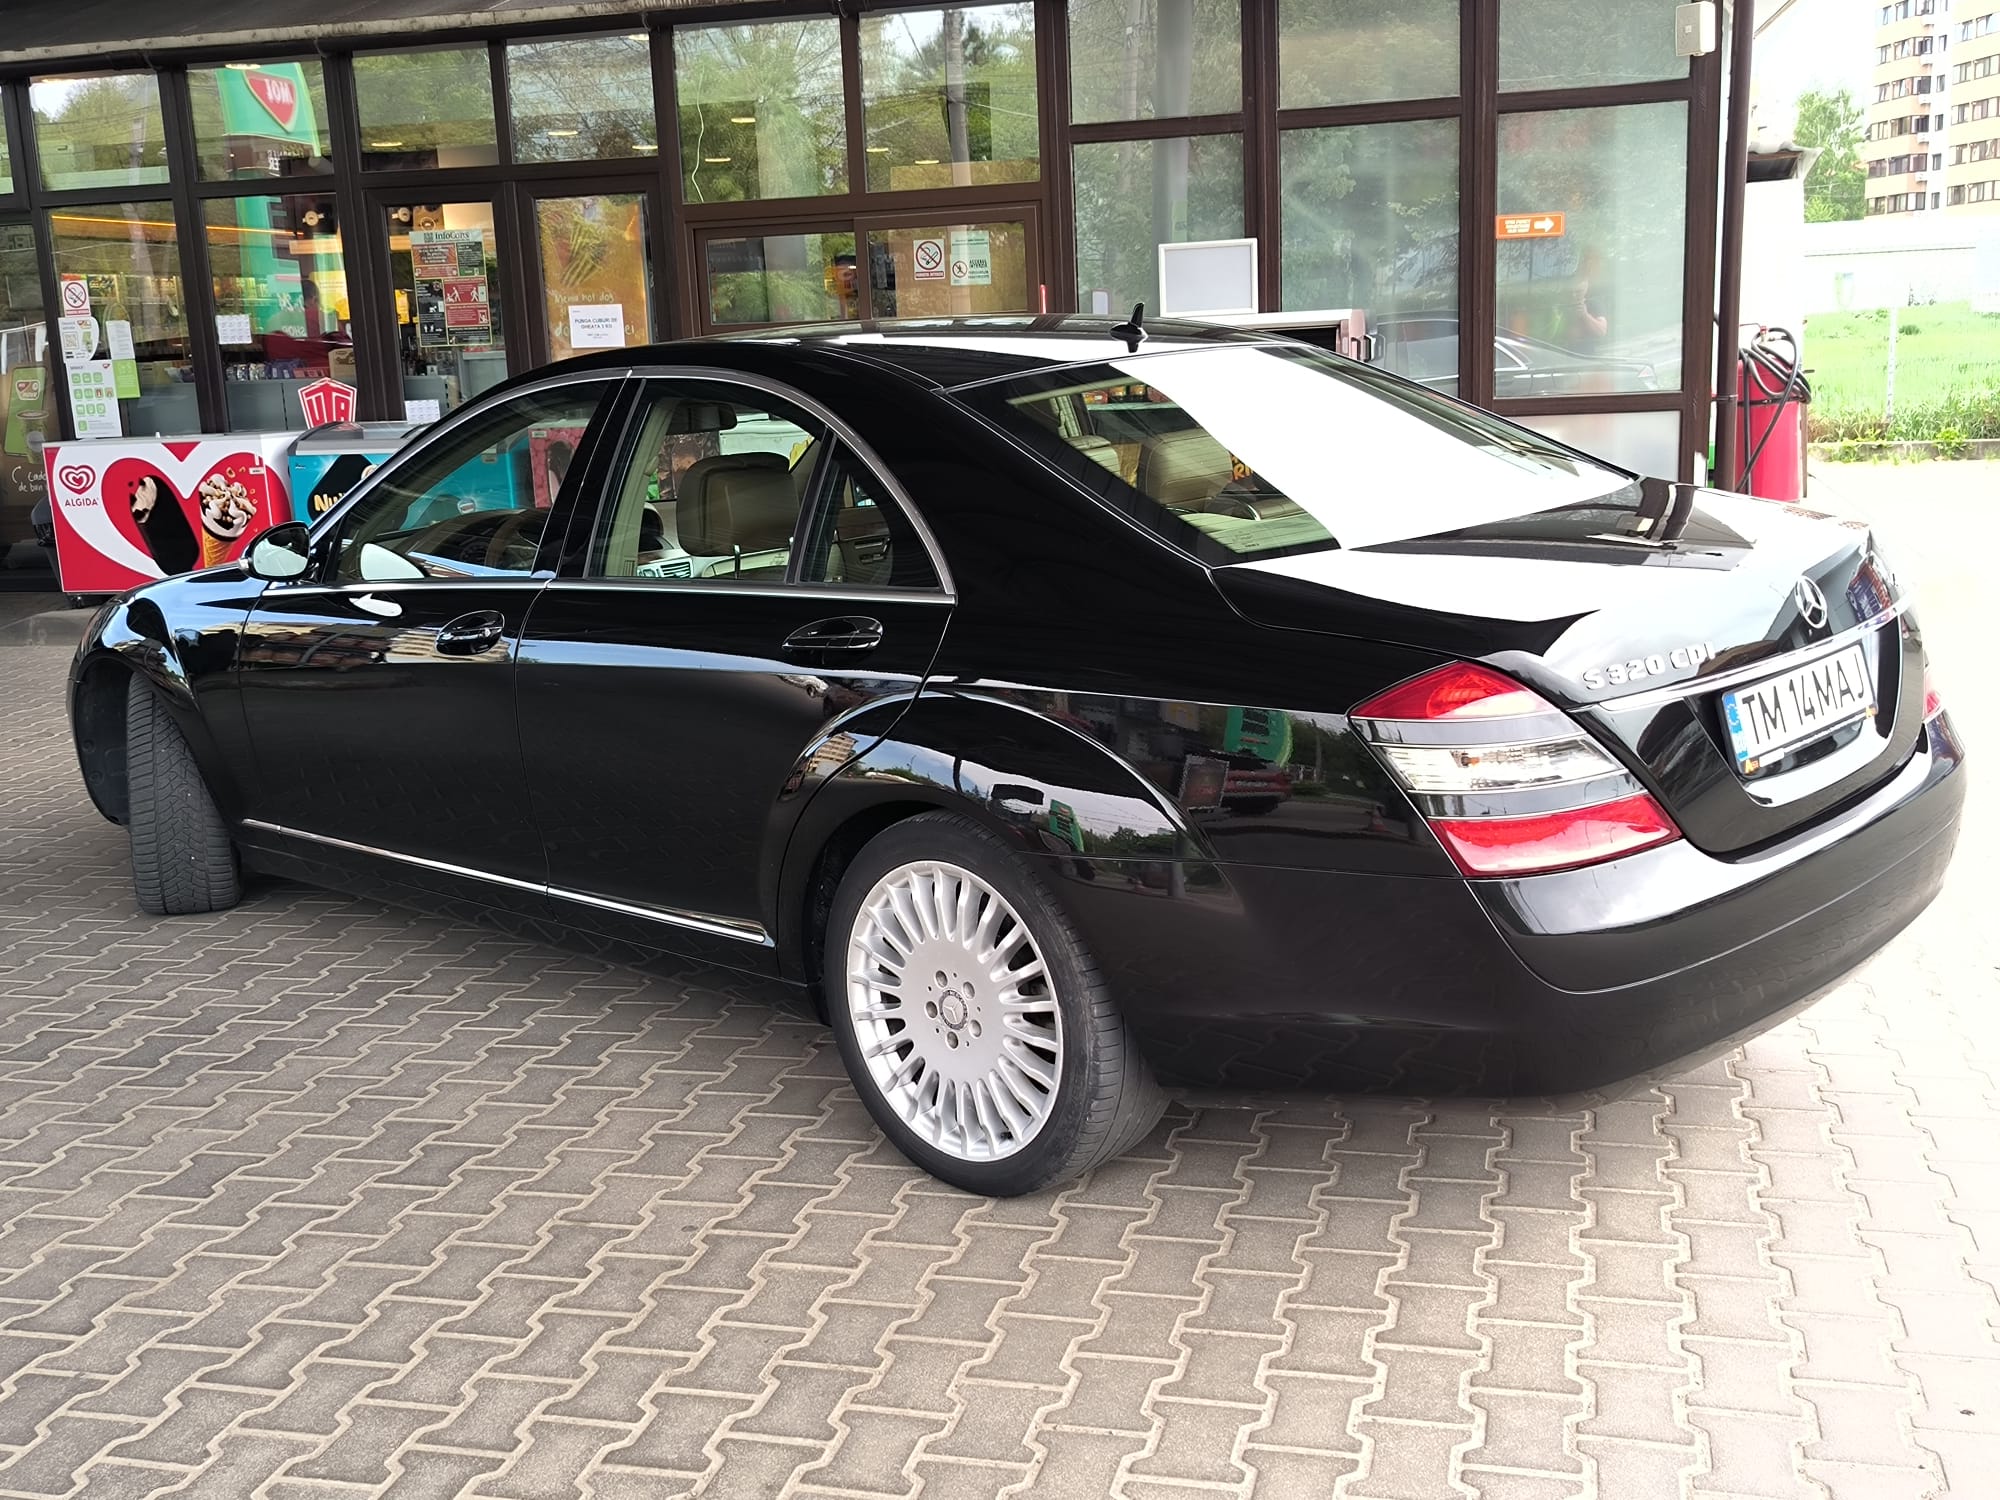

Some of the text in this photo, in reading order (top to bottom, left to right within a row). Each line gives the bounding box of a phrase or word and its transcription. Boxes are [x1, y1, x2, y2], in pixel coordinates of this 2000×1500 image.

[435, 231, 470, 240] InfoCons
[599, 291, 615, 303] dog
[65, 498, 98, 507] ALGIDA
[1582, 641, 1716, 691] S 320 CDI
[1741, 685, 1787, 745] TM
